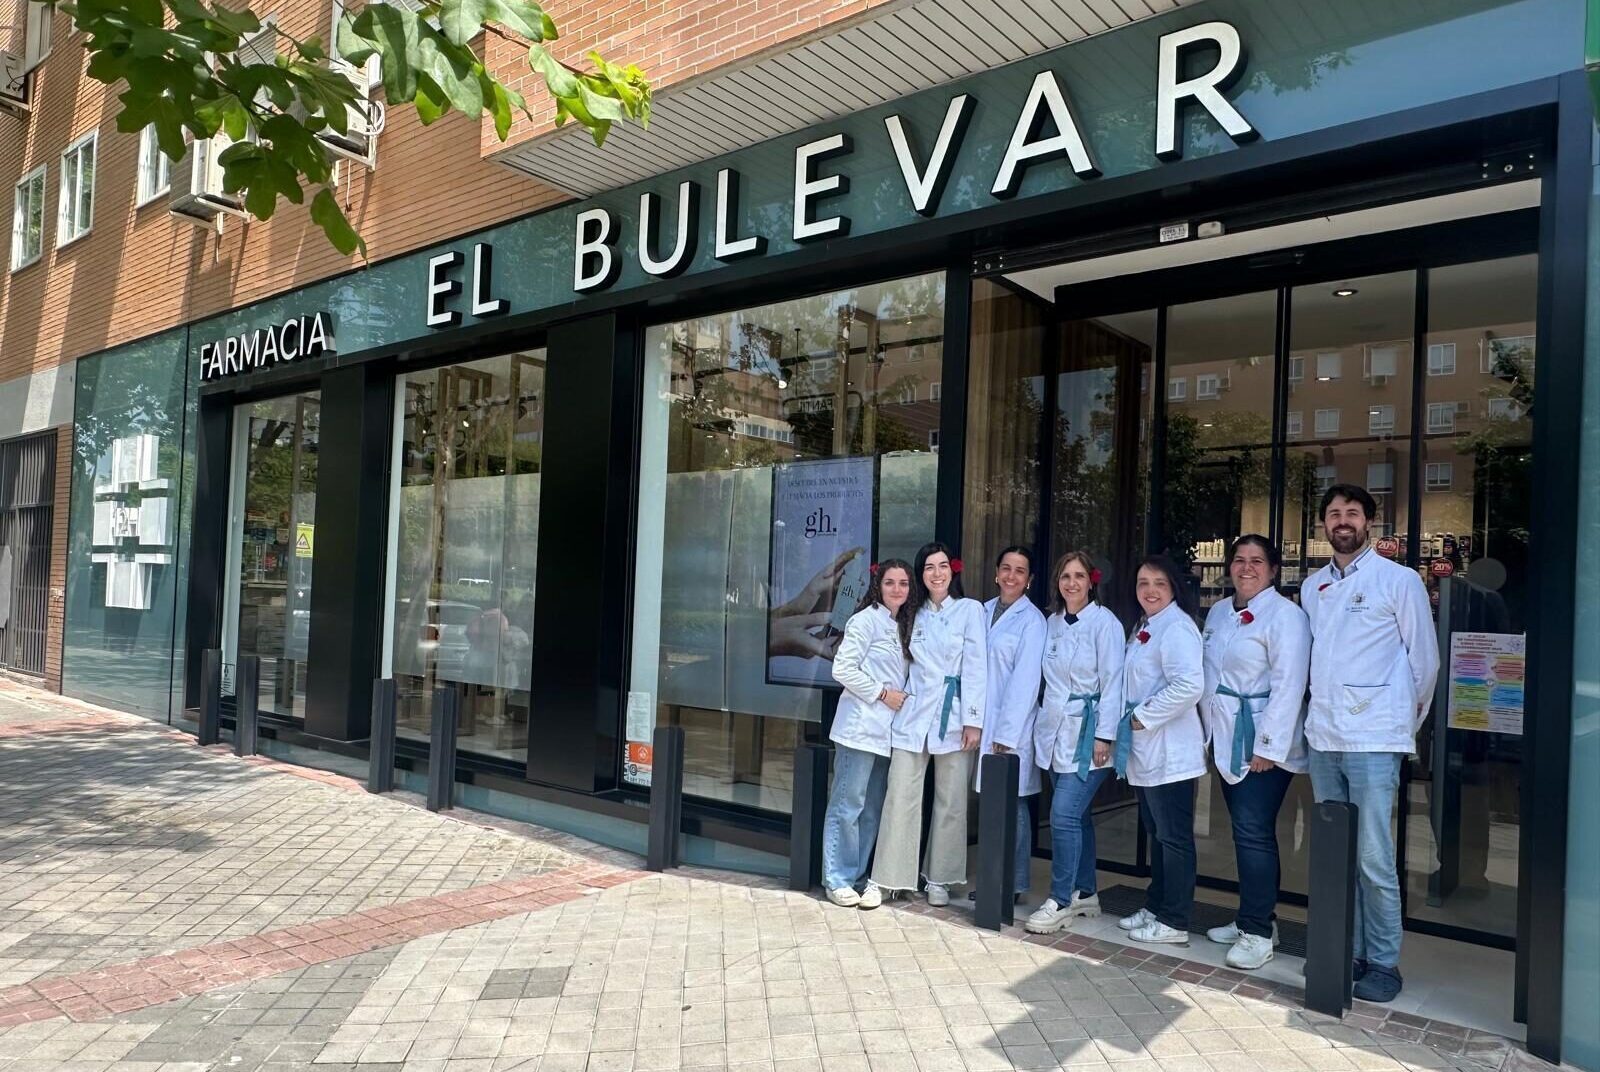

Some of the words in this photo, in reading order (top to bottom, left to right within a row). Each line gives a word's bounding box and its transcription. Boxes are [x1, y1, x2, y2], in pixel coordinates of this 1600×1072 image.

[200, 312, 327, 380] FARMACIA
[427, 243, 502, 326] EL
[573, 22, 1255, 292] BULEVAR
[804, 507, 837, 539] gh.
[1378, 540, 1397, 550] 20%
[1434, 562, 1451, 571] 20%
